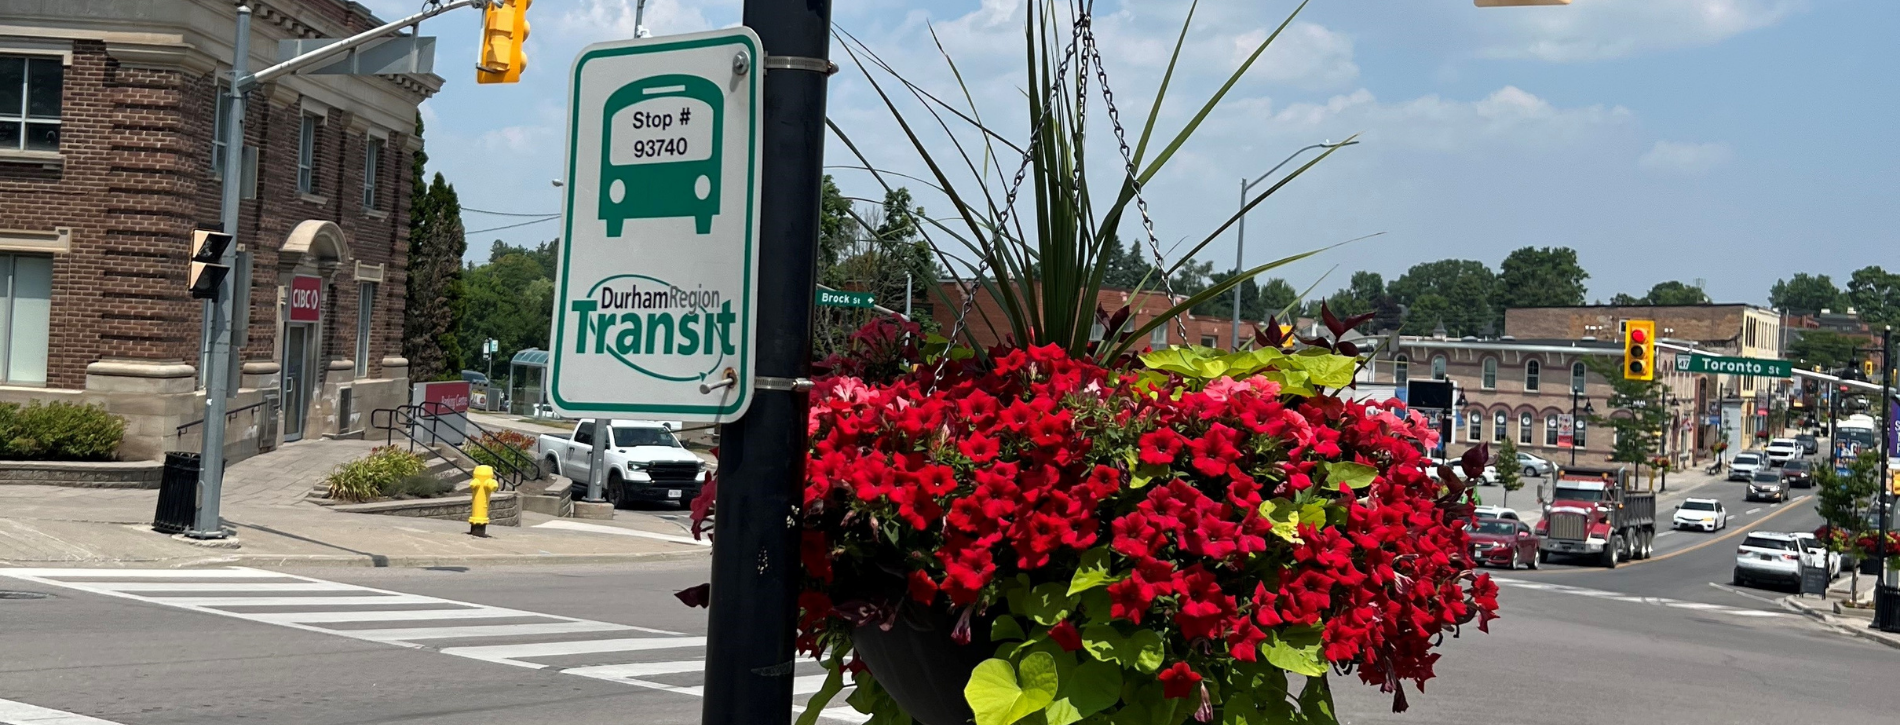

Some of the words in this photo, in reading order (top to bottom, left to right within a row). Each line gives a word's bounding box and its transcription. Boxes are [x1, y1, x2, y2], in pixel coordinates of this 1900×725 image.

[632, 111, 673, 130] Stop
[679, 107, 691, 125] #
[633, 137, 688, 158] 93740
[292, 289, 311, 308] CIBC
[821, 293, 850, 304] Brock
[571, 299, 736, 356] Transit
[1702, 358, 1762, 373] Toronto
[1768, 366, 1780, 375] St
